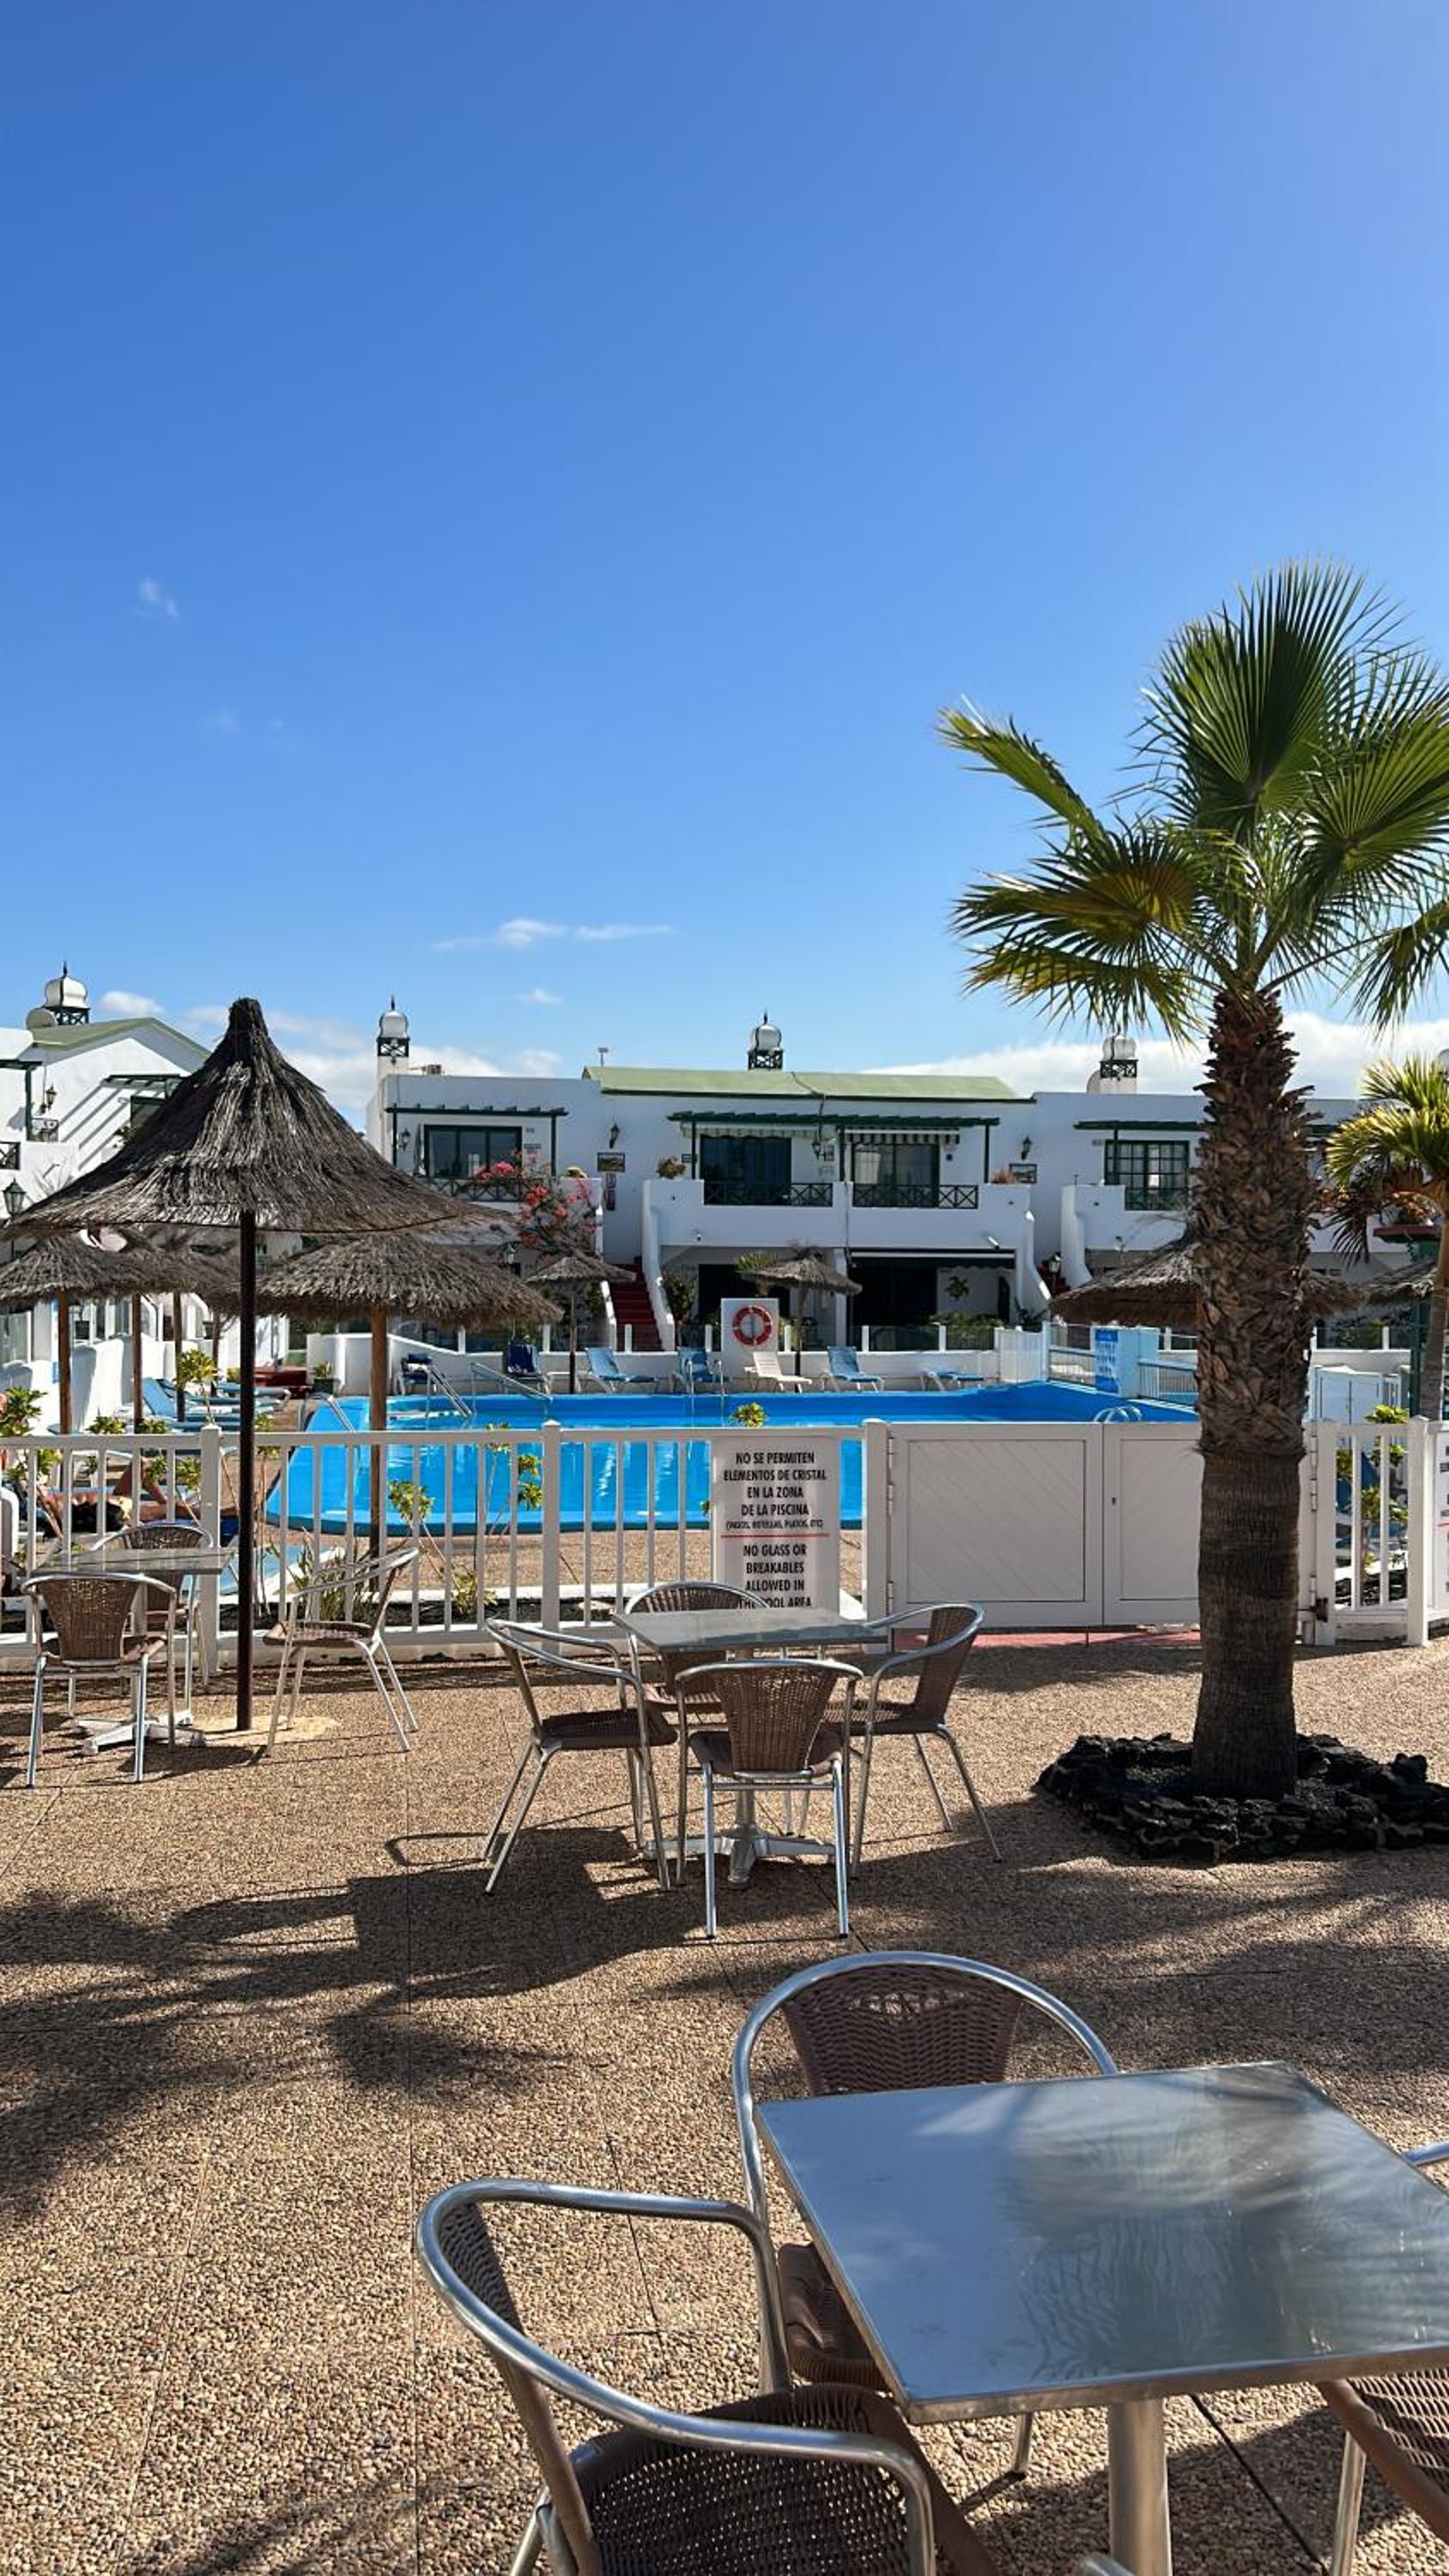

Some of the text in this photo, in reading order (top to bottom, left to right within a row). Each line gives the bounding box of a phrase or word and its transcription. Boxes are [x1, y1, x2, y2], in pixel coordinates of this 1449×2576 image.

[736, 1451, 815, 1464] NO SE PERMITEN
[724, 1469, 827, 1481] ELEMENTOS DE CRISTAL
[748, 1486, 804, 1498] EN LA ZONA
[741, 1504, 809, 1516] DE LA PISCINA
[743, 1544, 807, 1557] NO GLASS OR
[746, 1562, 804, 1574] BREAKABLES
[746, 1579, 804, 1591] ALLOWED IN
[788, 1597, 811, 1607] AREA
